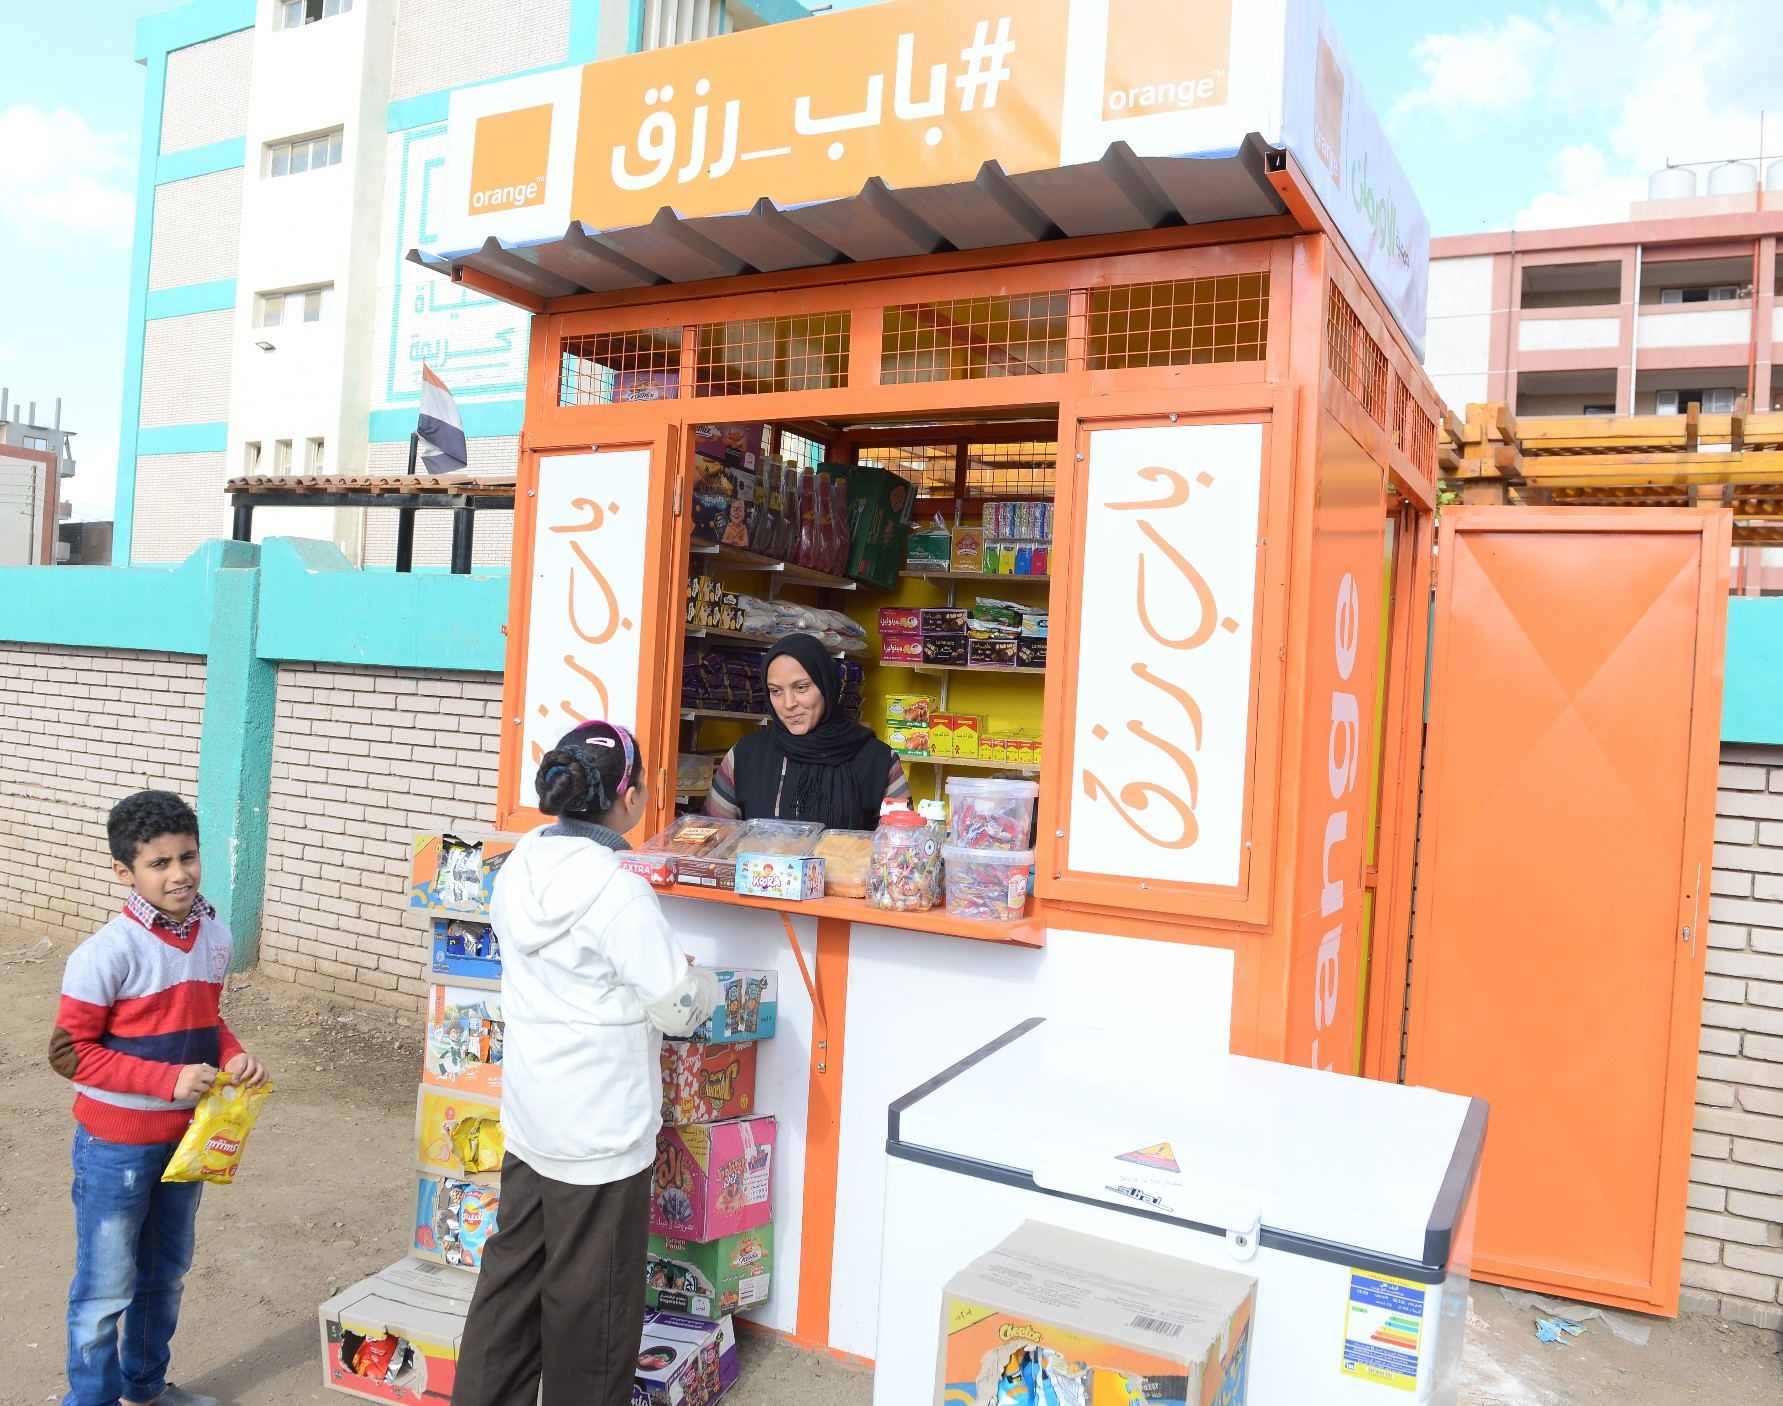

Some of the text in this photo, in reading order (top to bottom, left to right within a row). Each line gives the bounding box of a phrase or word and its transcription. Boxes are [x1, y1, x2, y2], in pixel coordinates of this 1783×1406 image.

[1108, 75, 1215, 111] orange
[1315, 126, 1339, 177] orange
[473, 181, 538, 208] orange
[622, 862, 651, 875] EXTRA
[999, 1323, 1043, 1343] Cheetos
